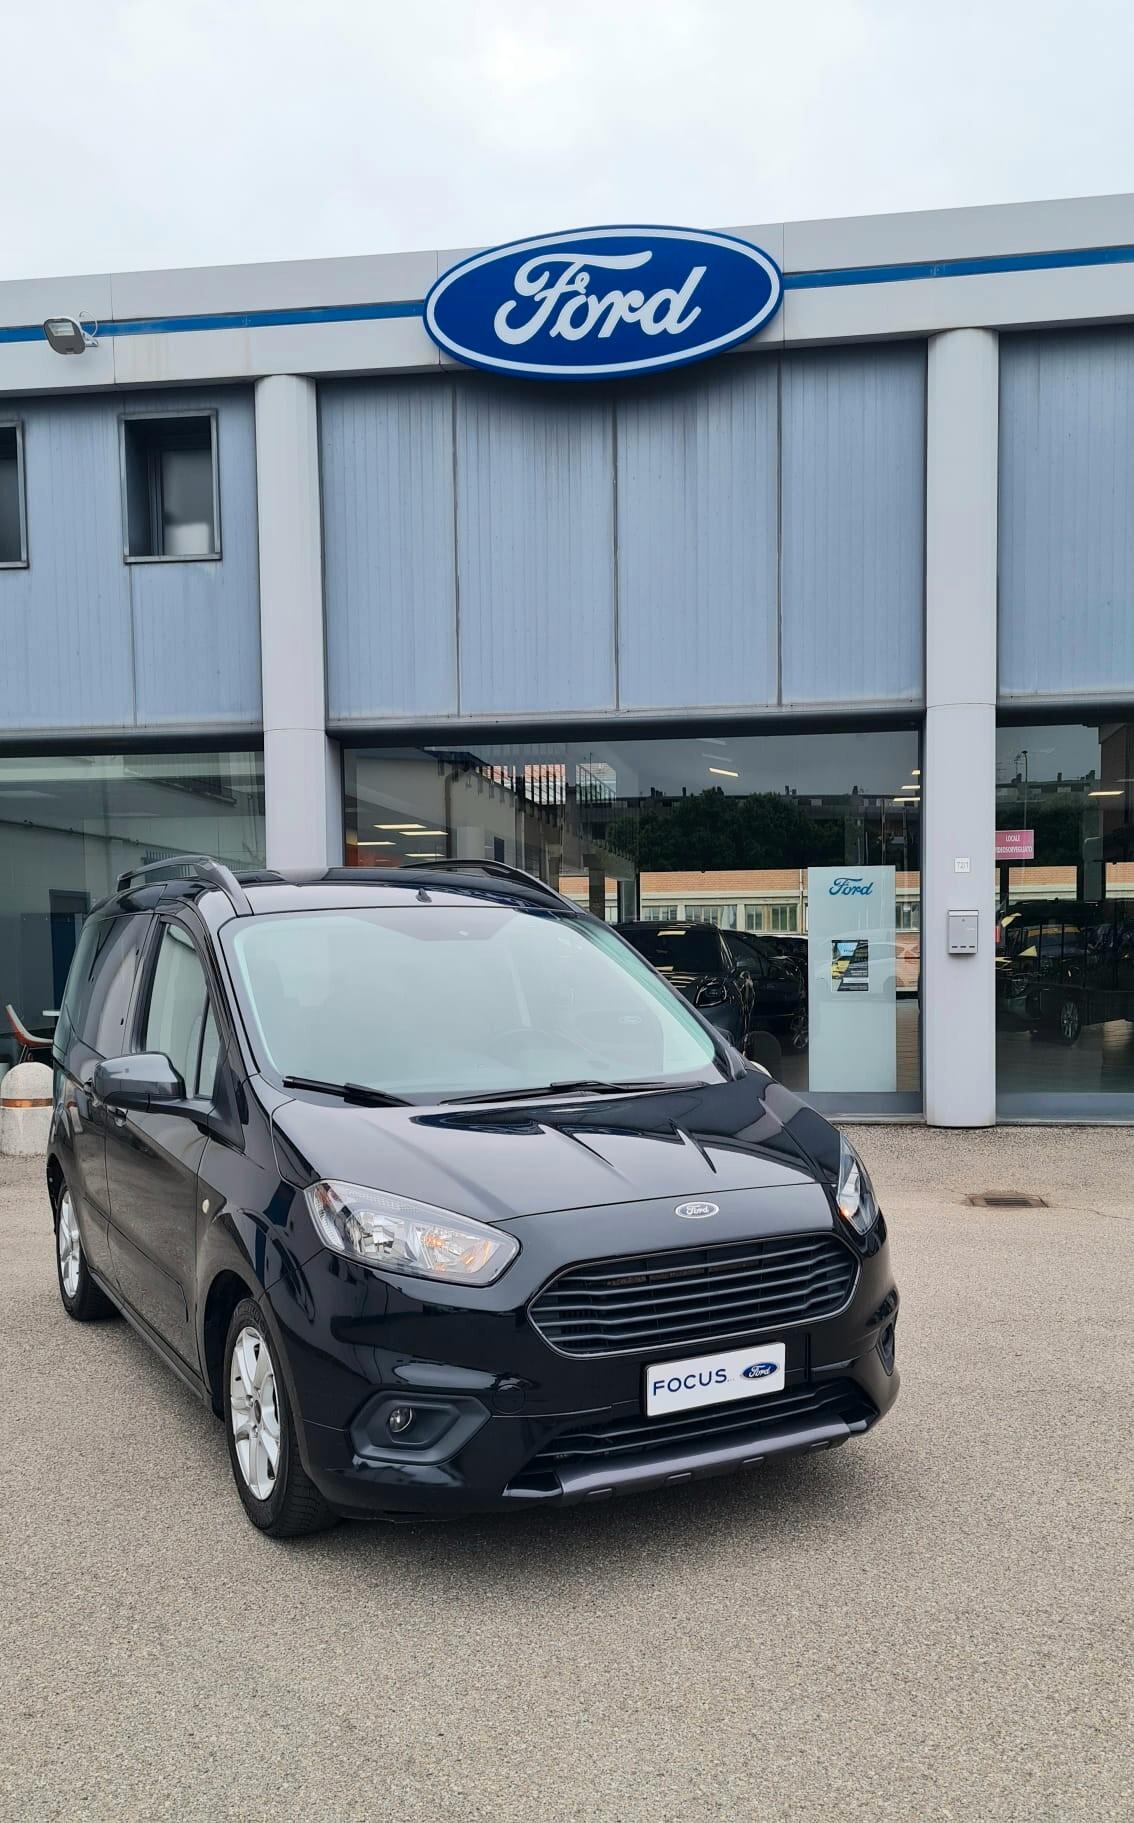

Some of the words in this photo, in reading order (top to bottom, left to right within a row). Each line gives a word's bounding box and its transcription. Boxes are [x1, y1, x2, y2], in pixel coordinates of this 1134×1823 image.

[494, 250, 706, 345] Ford
[829, 877, 873, 896] Ford
[686, 1204, 709, 1216] Ford
[653, 1368, 727, 1396] FOCUS
[748, 1364, 771, 1377] Ford
